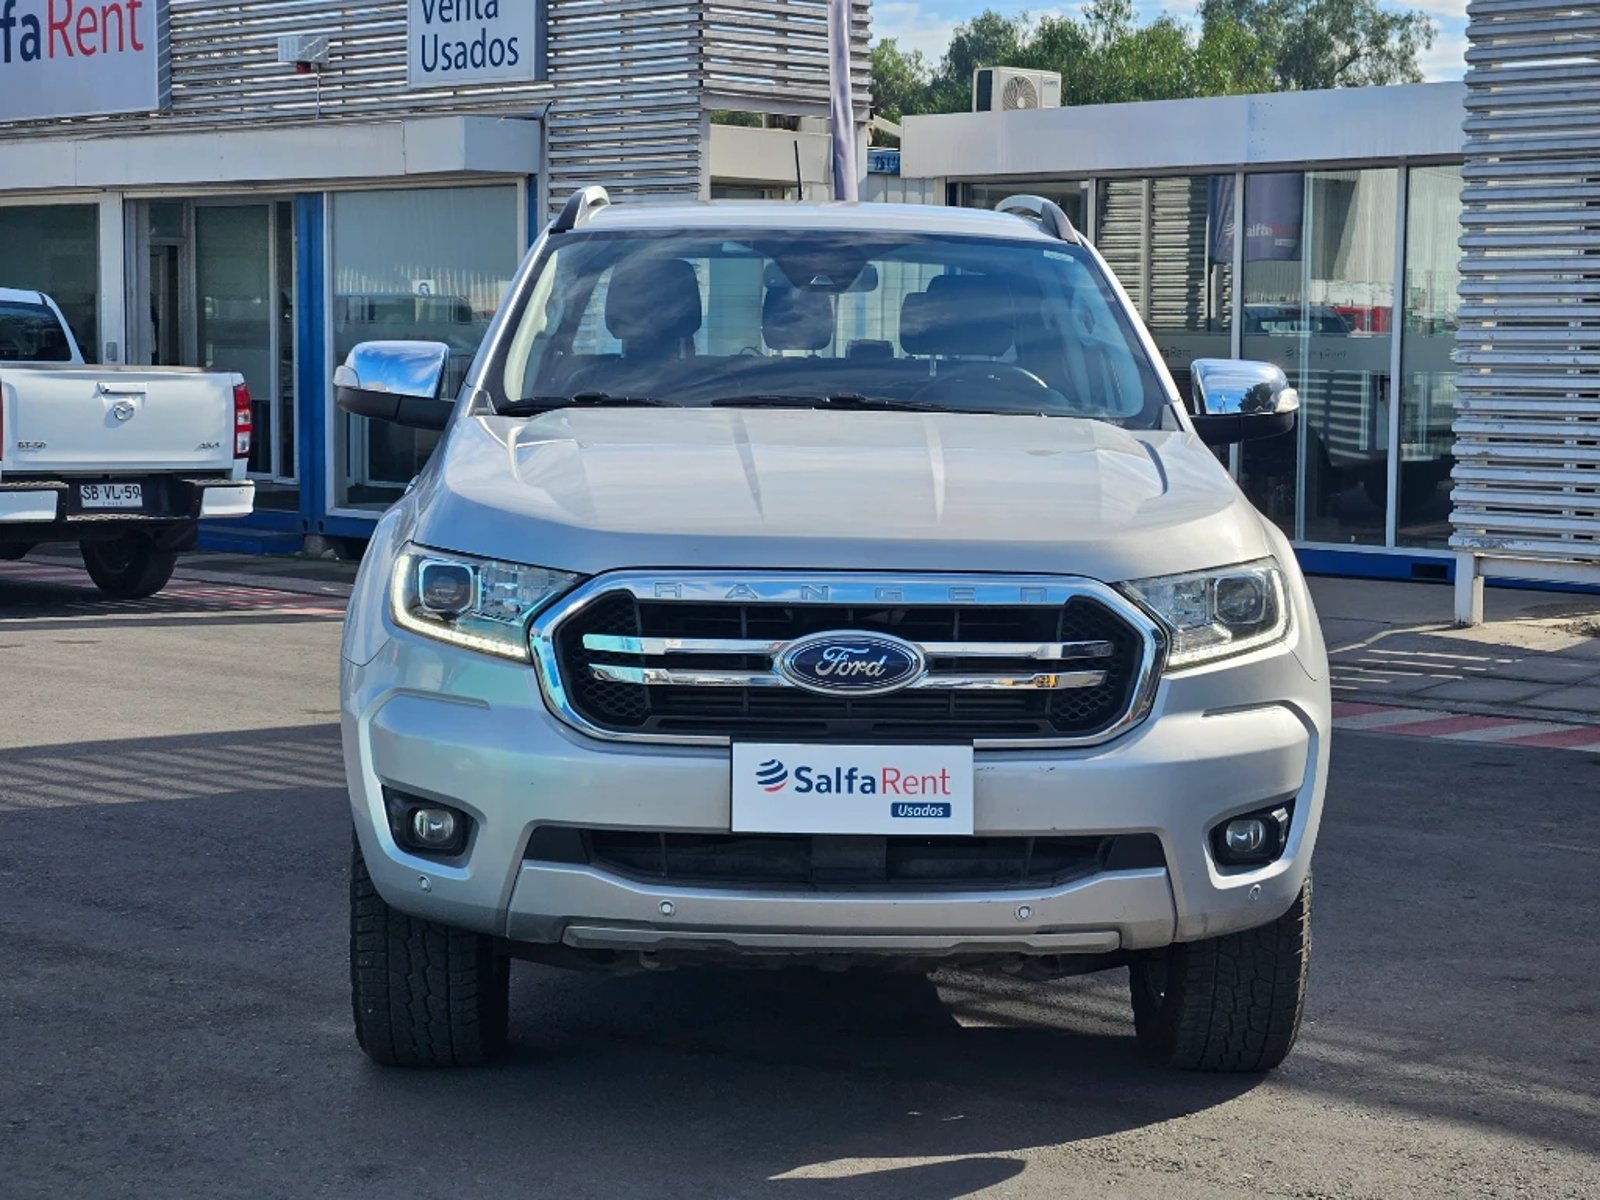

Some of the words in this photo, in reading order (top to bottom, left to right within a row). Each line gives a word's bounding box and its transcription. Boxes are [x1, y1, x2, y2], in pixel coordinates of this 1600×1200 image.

[421, 27, 519, 73] Usados
[653, 581, 1048, 603] RANGER
[815, 646, 888, 677] Ford
[897, 804, 944, 817] Usados
